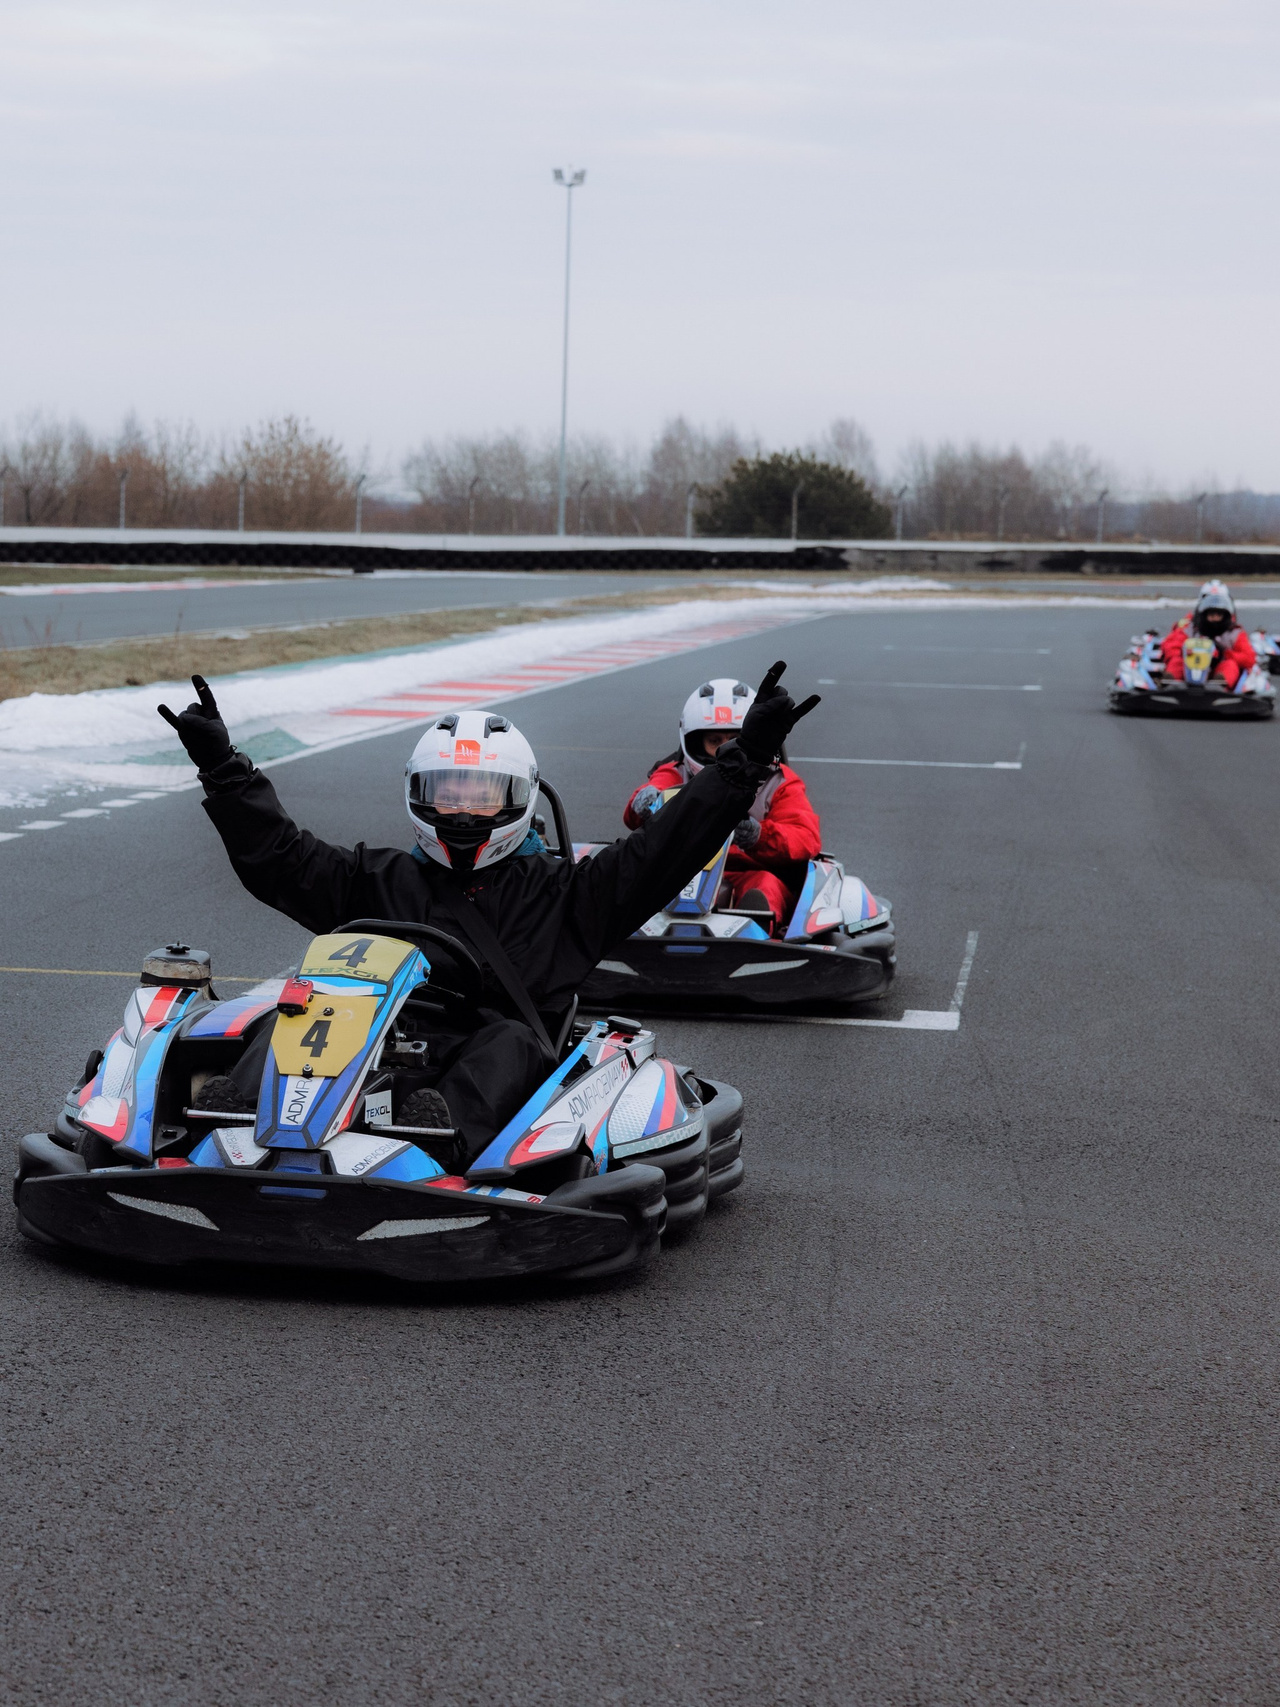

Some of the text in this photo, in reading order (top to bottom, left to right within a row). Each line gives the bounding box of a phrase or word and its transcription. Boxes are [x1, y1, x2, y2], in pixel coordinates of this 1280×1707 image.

[327, 938, 375, 968] 4
[300, 1020, 331, 1057] 4
[286, 1076, 313, 1124] ADMR
[567, 1061, 622, 1122] ADMRACEWAY
[366, 1105, 390, 1118] TEXOL
